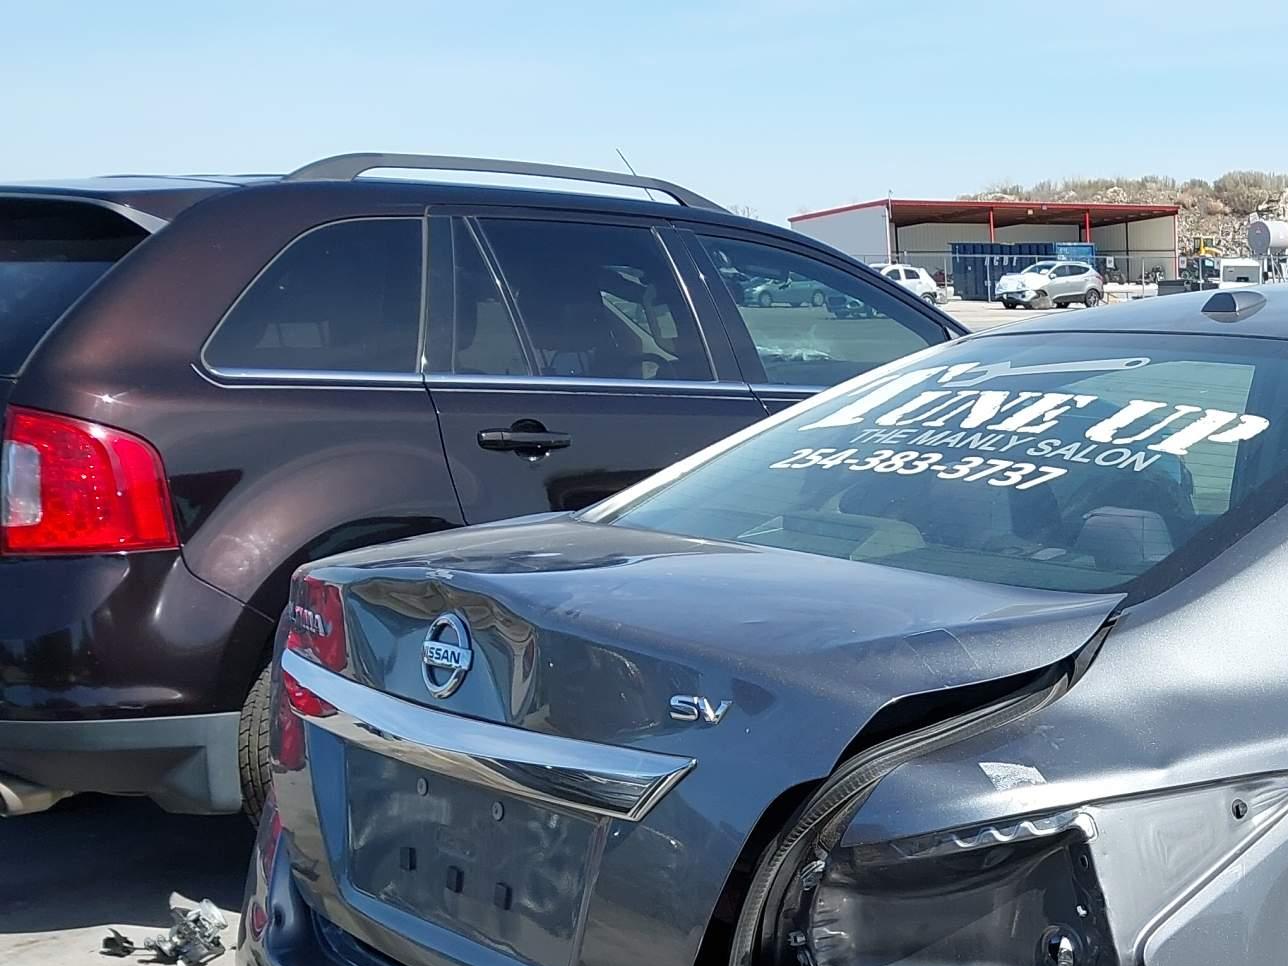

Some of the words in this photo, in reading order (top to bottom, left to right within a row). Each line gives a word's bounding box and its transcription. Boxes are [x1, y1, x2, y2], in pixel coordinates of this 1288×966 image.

[798, 362, 1098, 434] TUNE
[1085, 400, 1270, 455] UP
[768, 448, 1068, 490] 254-383-3737
[850, 428, 918, 443] THE
[907, 429, 1036, 452] MANLY
[1026, 438, 1161, 472] SALON
[670, 694, 733, 725] SV
